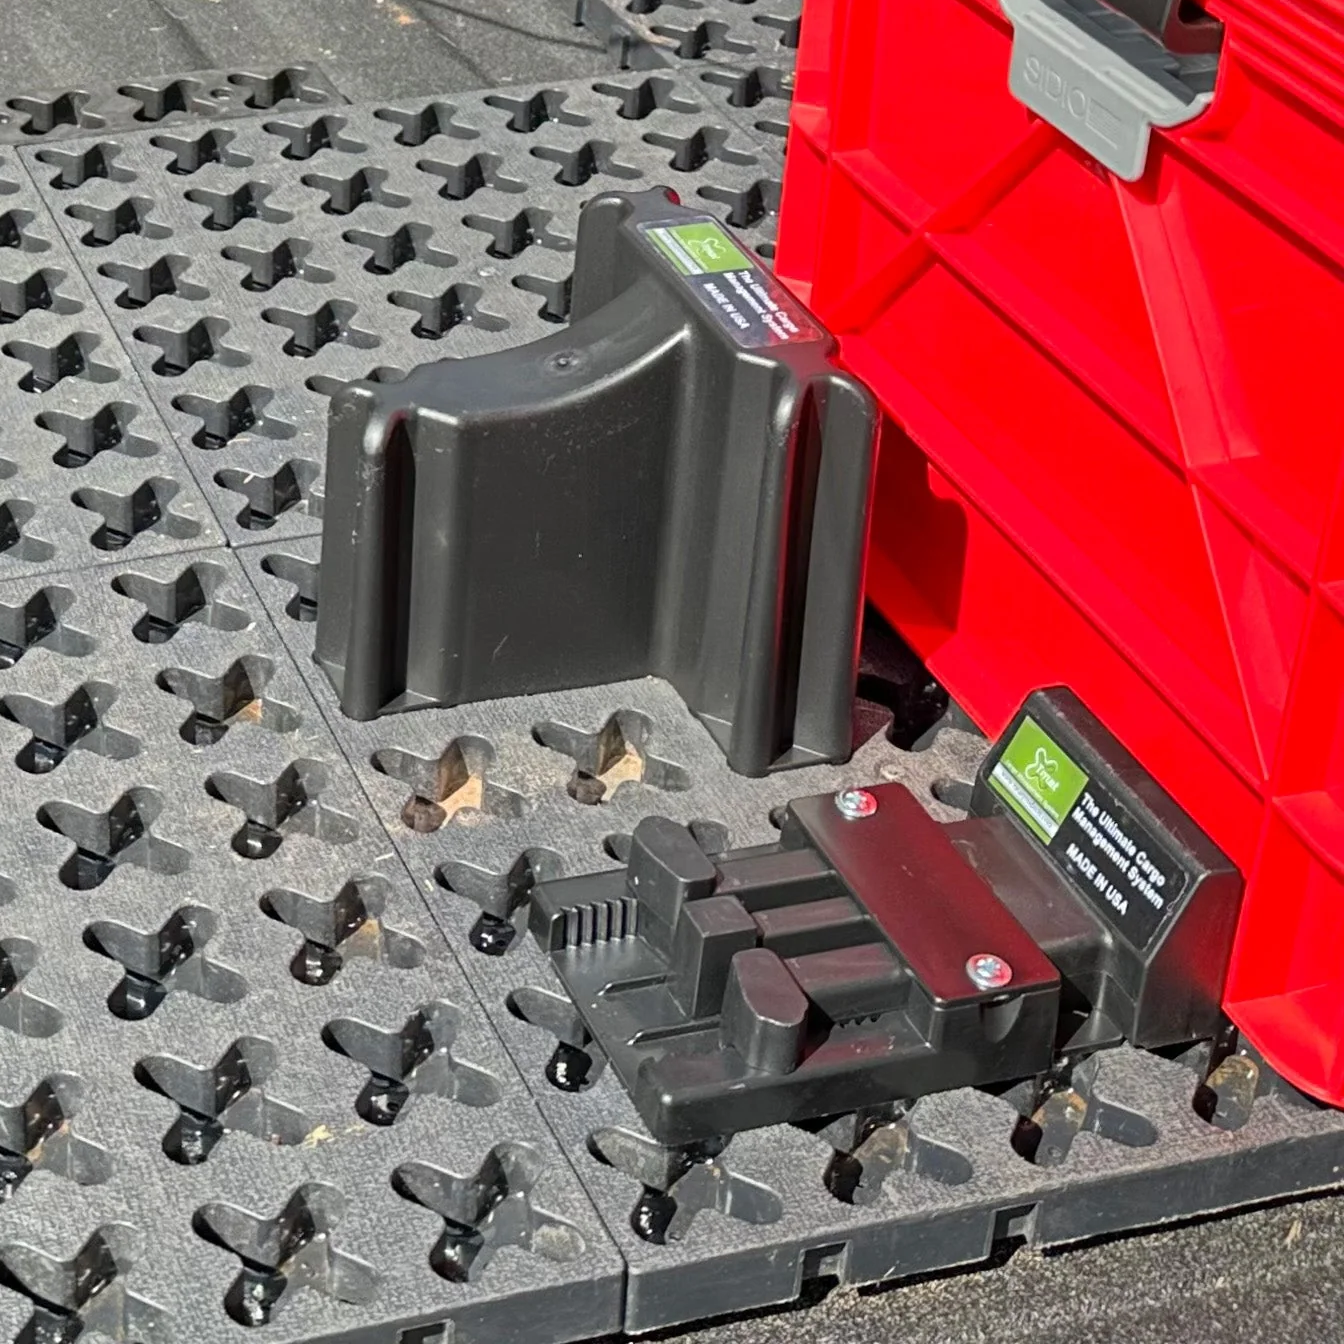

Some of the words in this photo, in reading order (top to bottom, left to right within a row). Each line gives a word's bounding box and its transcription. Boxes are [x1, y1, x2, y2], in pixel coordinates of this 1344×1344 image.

[1022, 55, 1086, 120] SIDIO
[703, 282, 730, 304] MADE
[730, 312, 750, 330] USA
[1071, 806, 1130, 873] Management
[1127, 865, 1164, 910] System
[1081, 791, 1100, 817] The
[1098, 810, 1136, 857] Ultimate
[1135, 850, 1166, 887] Cargo
[1065, 842, 1098, 880] MADE
[1093, 872, 1109, 892] IN
[1105, 884, 1128, 916] USA
